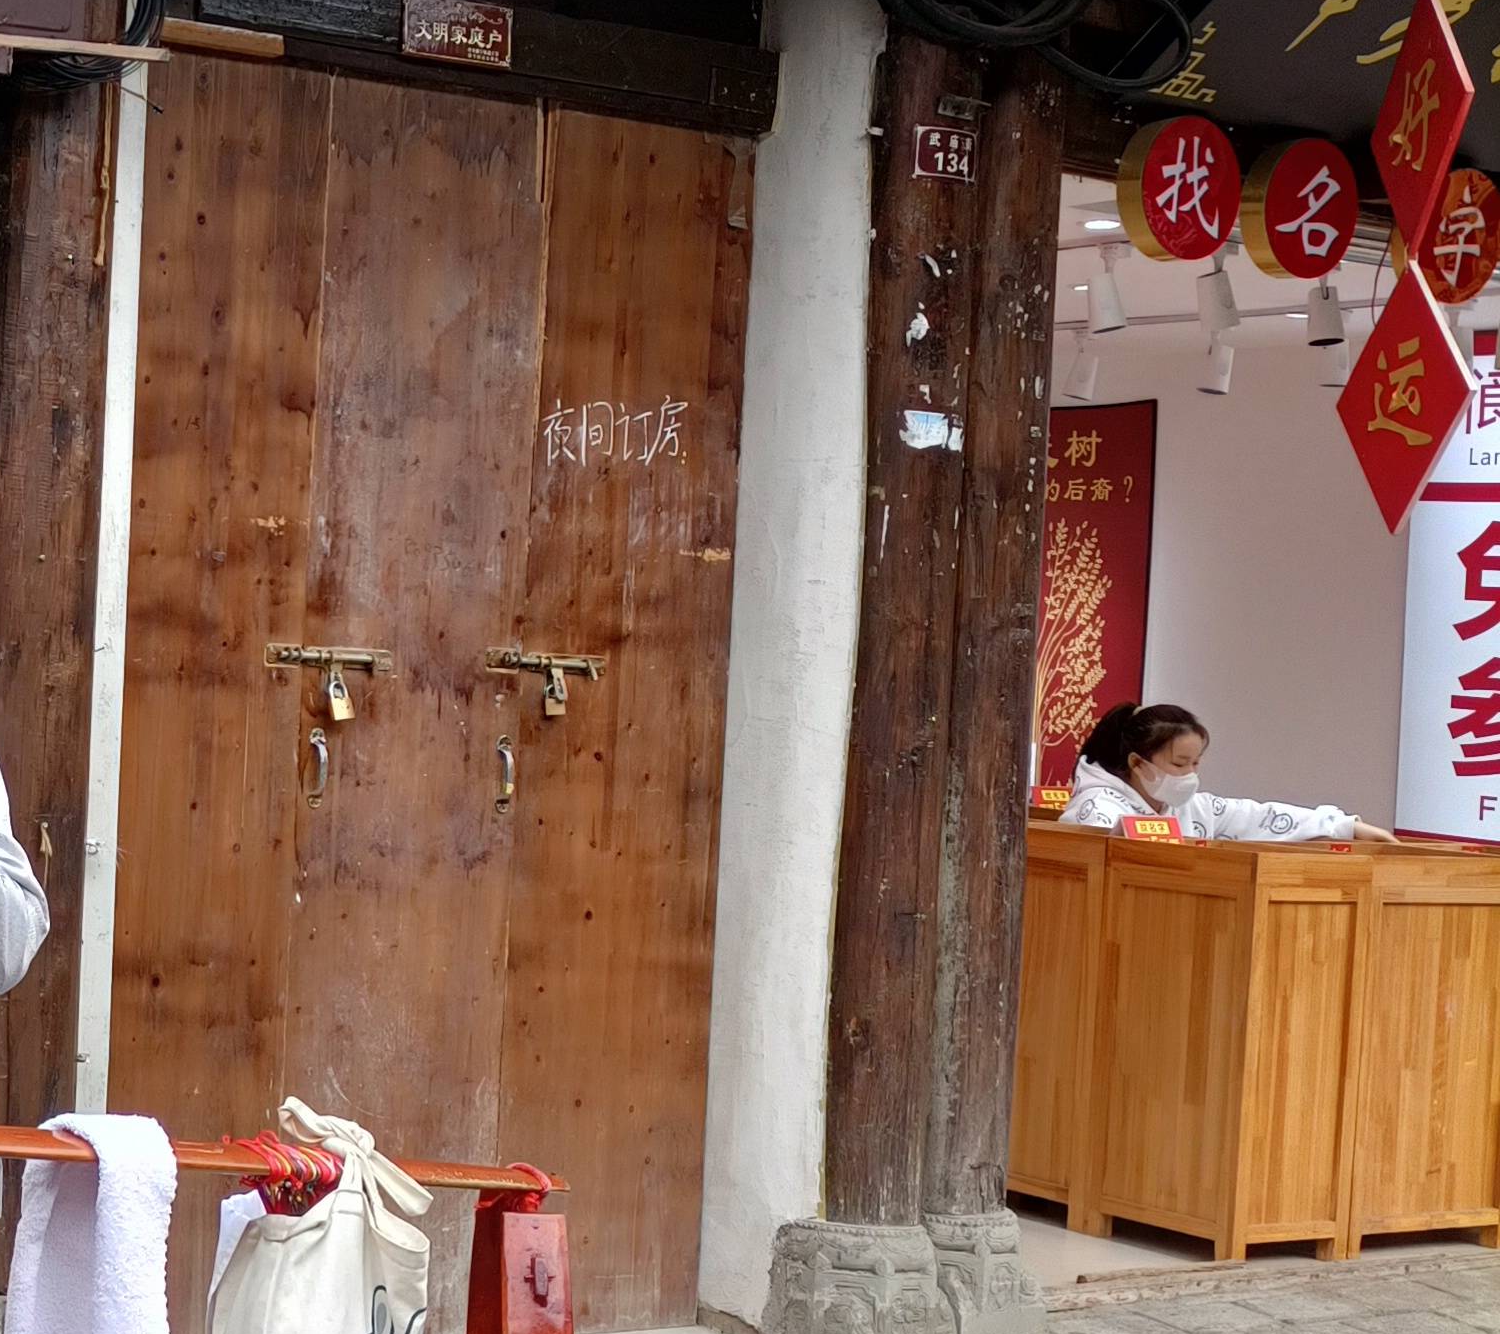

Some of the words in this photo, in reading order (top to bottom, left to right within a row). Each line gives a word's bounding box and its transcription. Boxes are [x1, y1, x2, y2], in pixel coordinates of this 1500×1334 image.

[414, 18, 503, 49] 文明家庭户
[933, 151, 969, 175] 134
[1155, 135, 1220, 241] 找
[1275, 164, 1342, 258] 名
[1433, 185, 1486, 288] 字
[1367, 336, 1434, 446] 运
